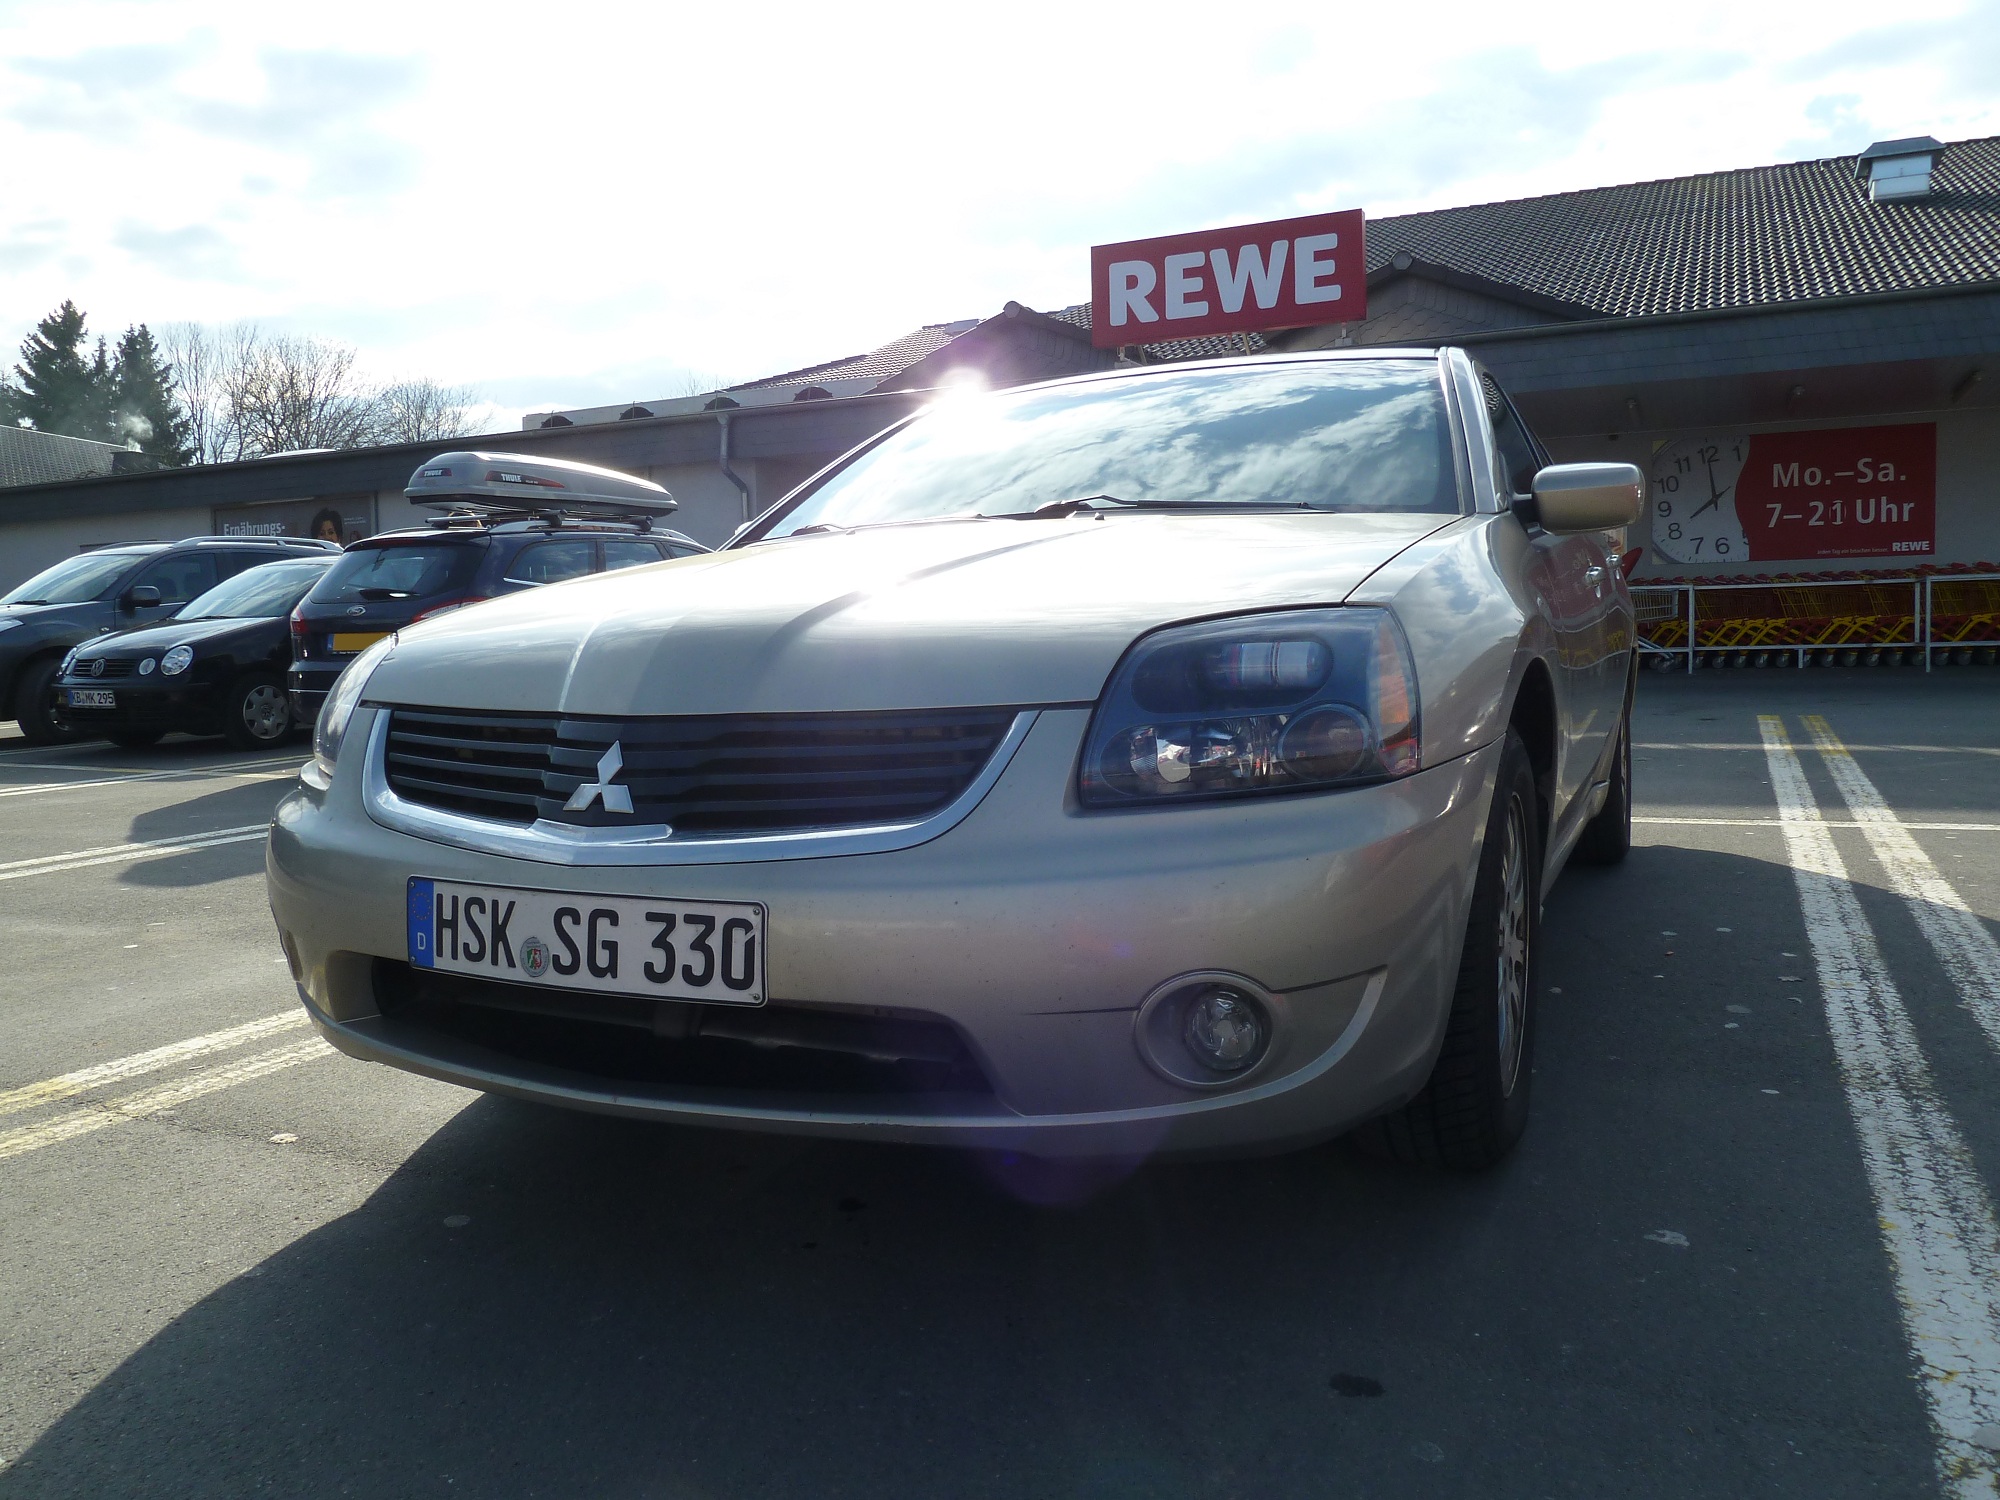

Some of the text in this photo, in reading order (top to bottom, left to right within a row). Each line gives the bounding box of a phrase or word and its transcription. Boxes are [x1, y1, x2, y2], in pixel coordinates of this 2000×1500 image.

[1108, 233, 1342, 326] REWE
[1698, 446, 1720, 464] 12
[1732, 445, 1741, 461] 1
[1674, 456, 1691, 473] 11
[501, 473, 522, 482] THULE
[1653, 475, 1679, 493] 10
[1658, 501, 1672, 517] 9
[1855, 496, 1915, 524] Uhr
[223, 521, 286, 537] Ernährungs-
[1668, 522, 1682, 540] 8
[1690, 537, 1704, 554] 7
[1715, 537, 1730, 554] 6
[1892, 541, 1930, 552] REWE
[97, 692, 114, 704] 295
[417, 932, 426, 950] D
[436, 893, 517, 969] HSK
[551, 906, 620, 979] SG
[643, 911, 756, 990] 330
